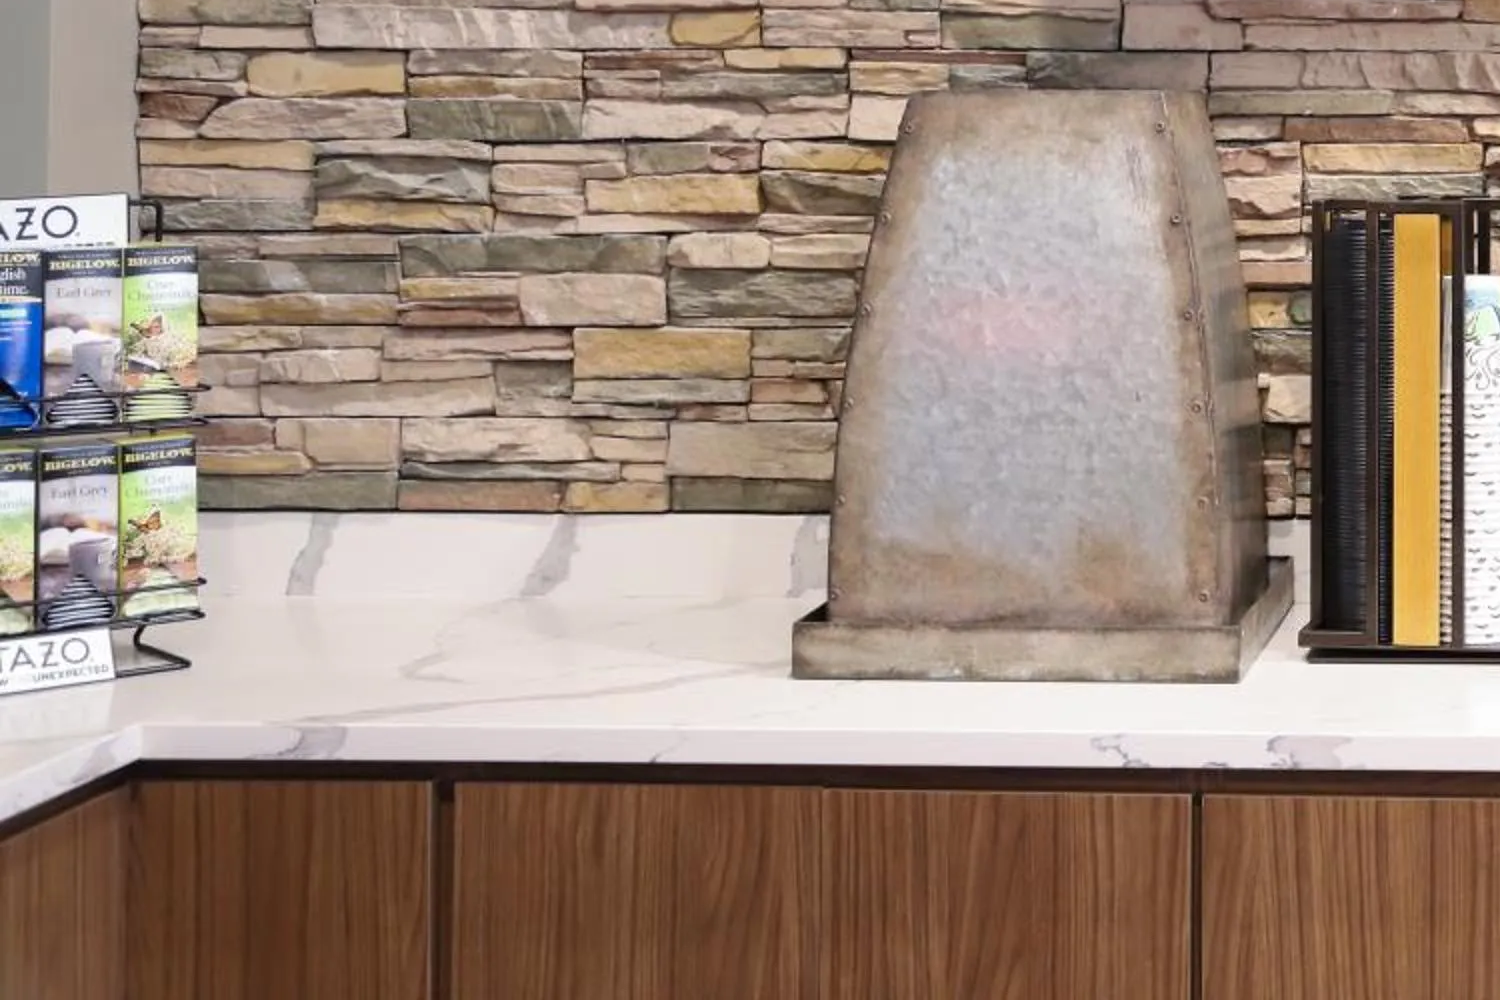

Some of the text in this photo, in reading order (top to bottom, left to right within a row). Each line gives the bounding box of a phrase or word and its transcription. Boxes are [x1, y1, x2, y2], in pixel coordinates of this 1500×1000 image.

[0, 253, 41, 263] LOW
[49, 257, 120, 271] BIGELOW
[127, 255, 195, 267] BIGELOW
[124, 447, 193, 463] BIGELOW
[44, 455, 117, 471] BIGELOW
